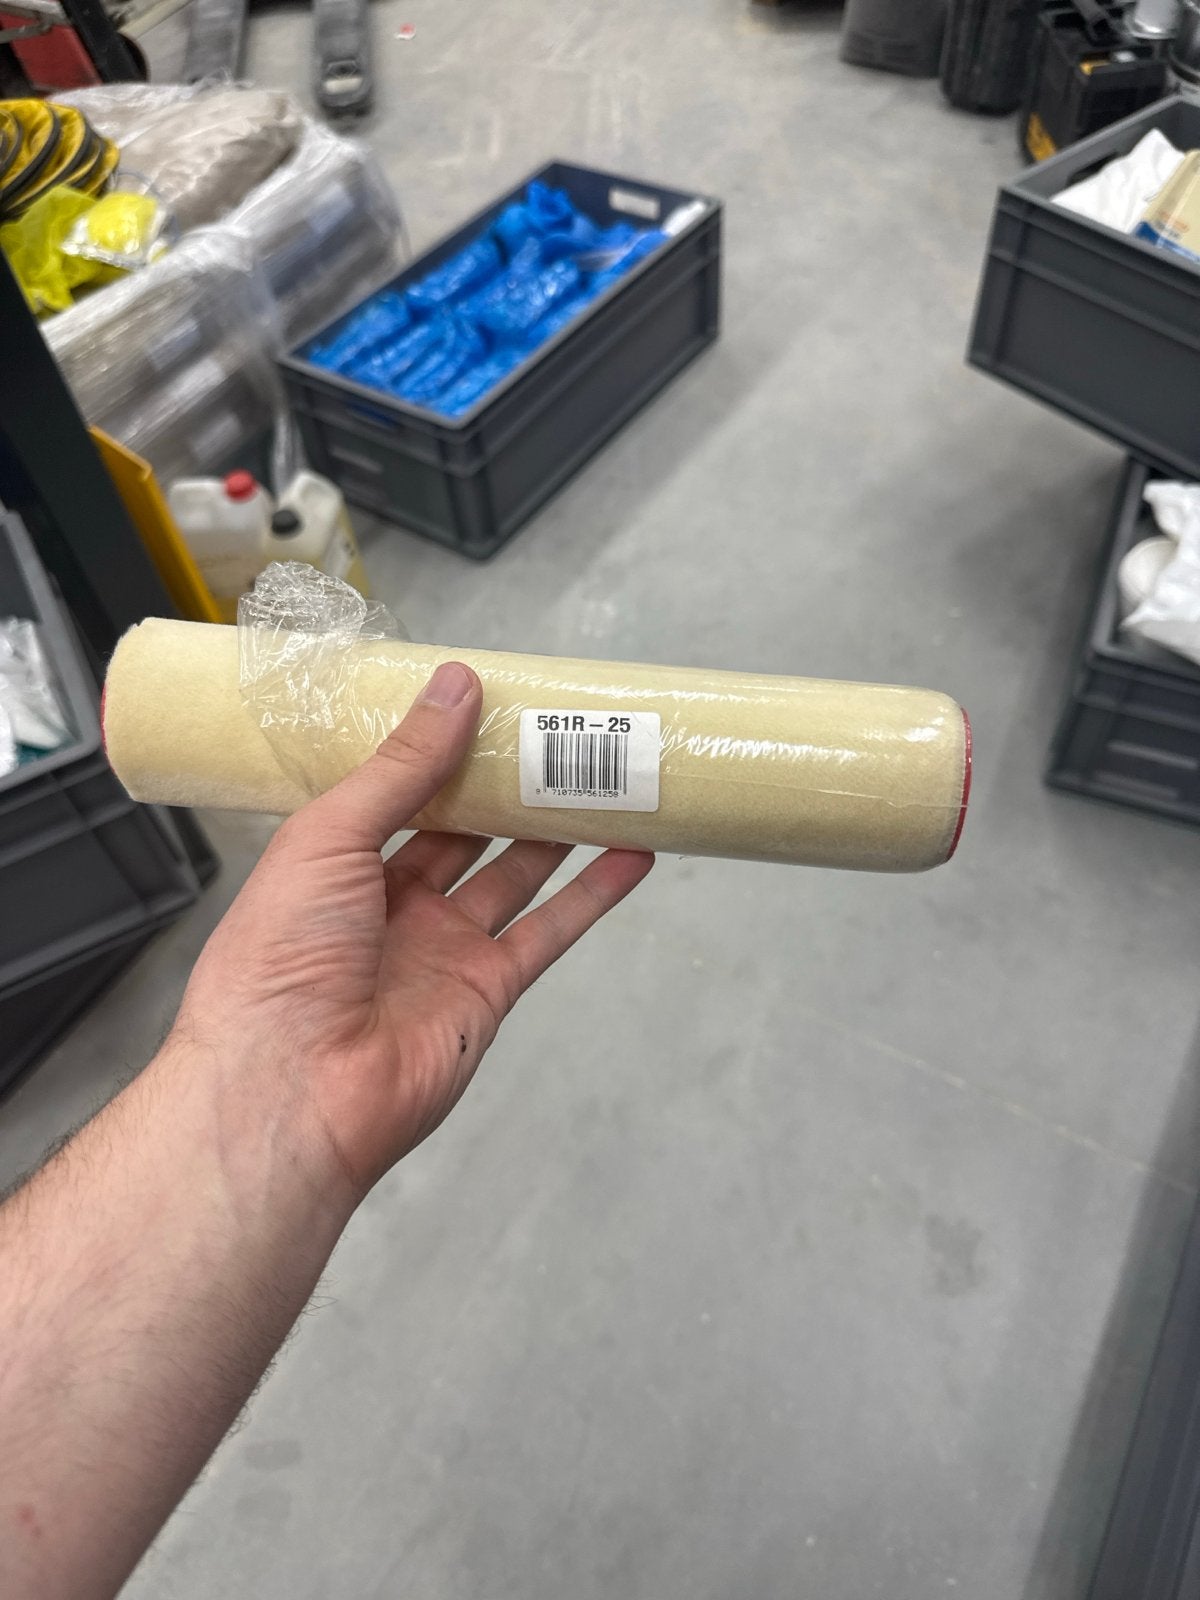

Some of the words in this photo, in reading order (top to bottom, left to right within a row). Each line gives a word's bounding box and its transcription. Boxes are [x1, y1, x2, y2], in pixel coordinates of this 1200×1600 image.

[537, 715, 585, 732] 561R
[608, 717, 631, 733] 25
[552, 788, 583, 797] 710735
